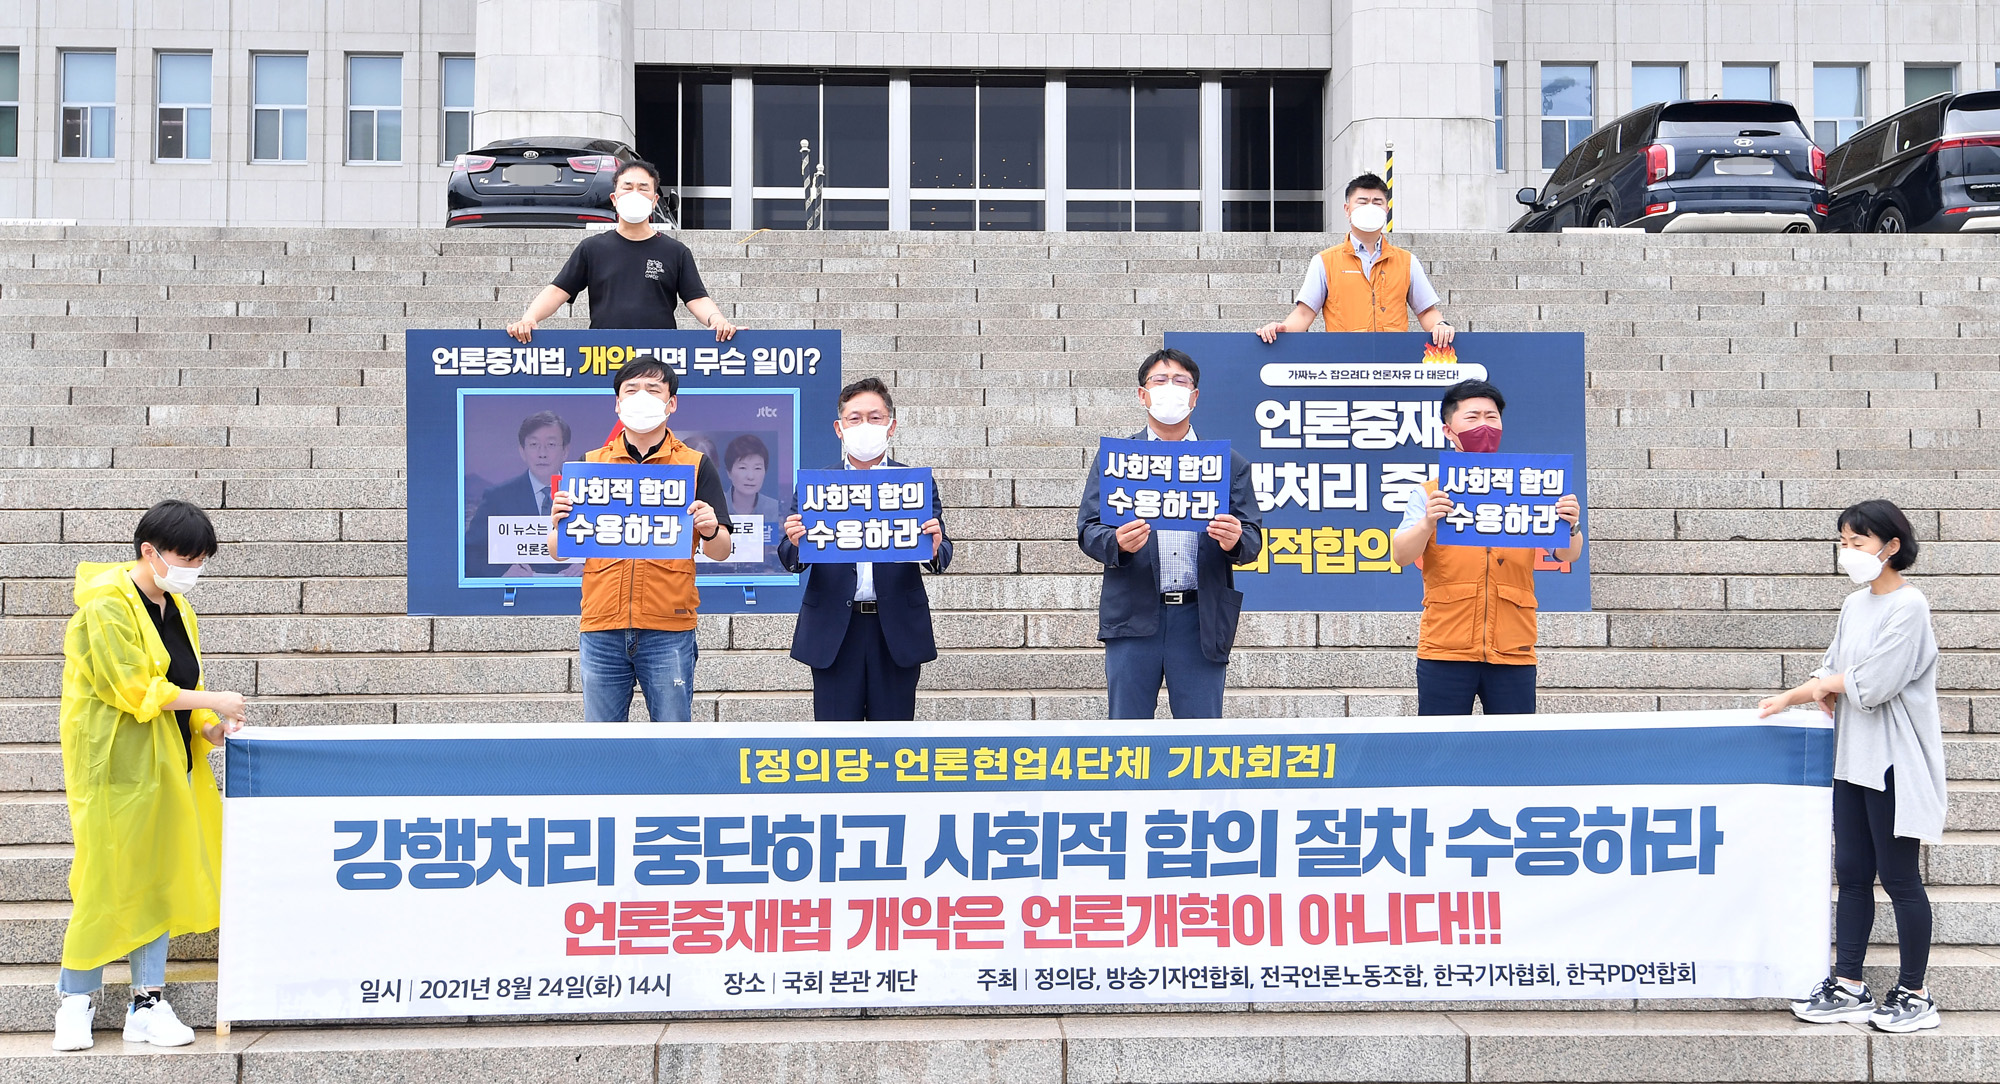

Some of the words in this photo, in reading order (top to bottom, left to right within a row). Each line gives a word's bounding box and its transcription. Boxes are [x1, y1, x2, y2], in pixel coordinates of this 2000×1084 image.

[431, 347, 573, 377] 언론중재법,
[693, 347, 746, 375] 무슨
[751, 346, 822, 375] 일이?
[1288, 369, 1328, 380] 가짜뉴스
[1330, 369, 1370, 380] 잡으려다
[1372, 369, 1411, 380] 언론자유
[1414, 369, 1425, 380] 다
[1426, 369, 1460, 380] 태운다!
[1254, 399, 1455, 450] 언론중재
[1104, 452, 1172, 481] 사회적
[1178, 454, 1223, 483] 합의
[1443, 466, 1514, 495] 사회적
[1519, 467, 1565, 496] 합의
[567, 477, 633, 506] 사회적
[638, 477, 687, 507] 합의
[802, 483, 872, 511] 사회적
[877, 482, 924, 510] 합의
[1107, 486, 1220, 520] 수용하라
[498, 523, 509, 536] 이
[513, 523, 548, 536] 뉴스는
[566, 513, 682, 546] 수용하라
[806, 518, 922, 550] 수용하라
[1445, 503, 1560, 535] 수용하라
[739, 746, 1150, 784] [정의당-언론현업4단체
[1167, 743, 1336, 779] 기자회견]
[333, 816, 616, 891] 강행처리
[632, 814, 907, 886] 중단하고
[924, 810, 1127, 881] 사회적
[1145, 809, 1279, 879] 합의
[1295, 807, 1434, 878] 절차
[1445, 805, 1725, 876] 수용하라
[564, 897, 832, 956] 언론중재법
[847, 895, 1006, 951] 개악은
[1020, 892, 1283, 949] 언론개혁이
[1299, 891, 1502, 946] 아니다!!!
[360, 978, 402, 1003] 일시
[419, 976, 491, 1000] 2021년
[496, 975, 532, 1000] 8월
[538, 974, 622, 999] 24일(화)
[628, 973, 672, 997] 14시
[723, 971, 766, 995] 장소
[782, 970, 823, 994] 국회
[829, 969, 871, 993] 본관
[876, 968, 918, 992] 계단
[977, 967, 1018, 991] 주최
[1034, 966, 1101, 990] 정의당,
[1106, 965, 1254, 990] 방송기자연합회,
[1261, 964, 1428, 989] 전국언론노동조합,
[1433, 963, 1561, 988] 한국기자협회,
[1566, 961, 1697, 986] 한국PD연합회
